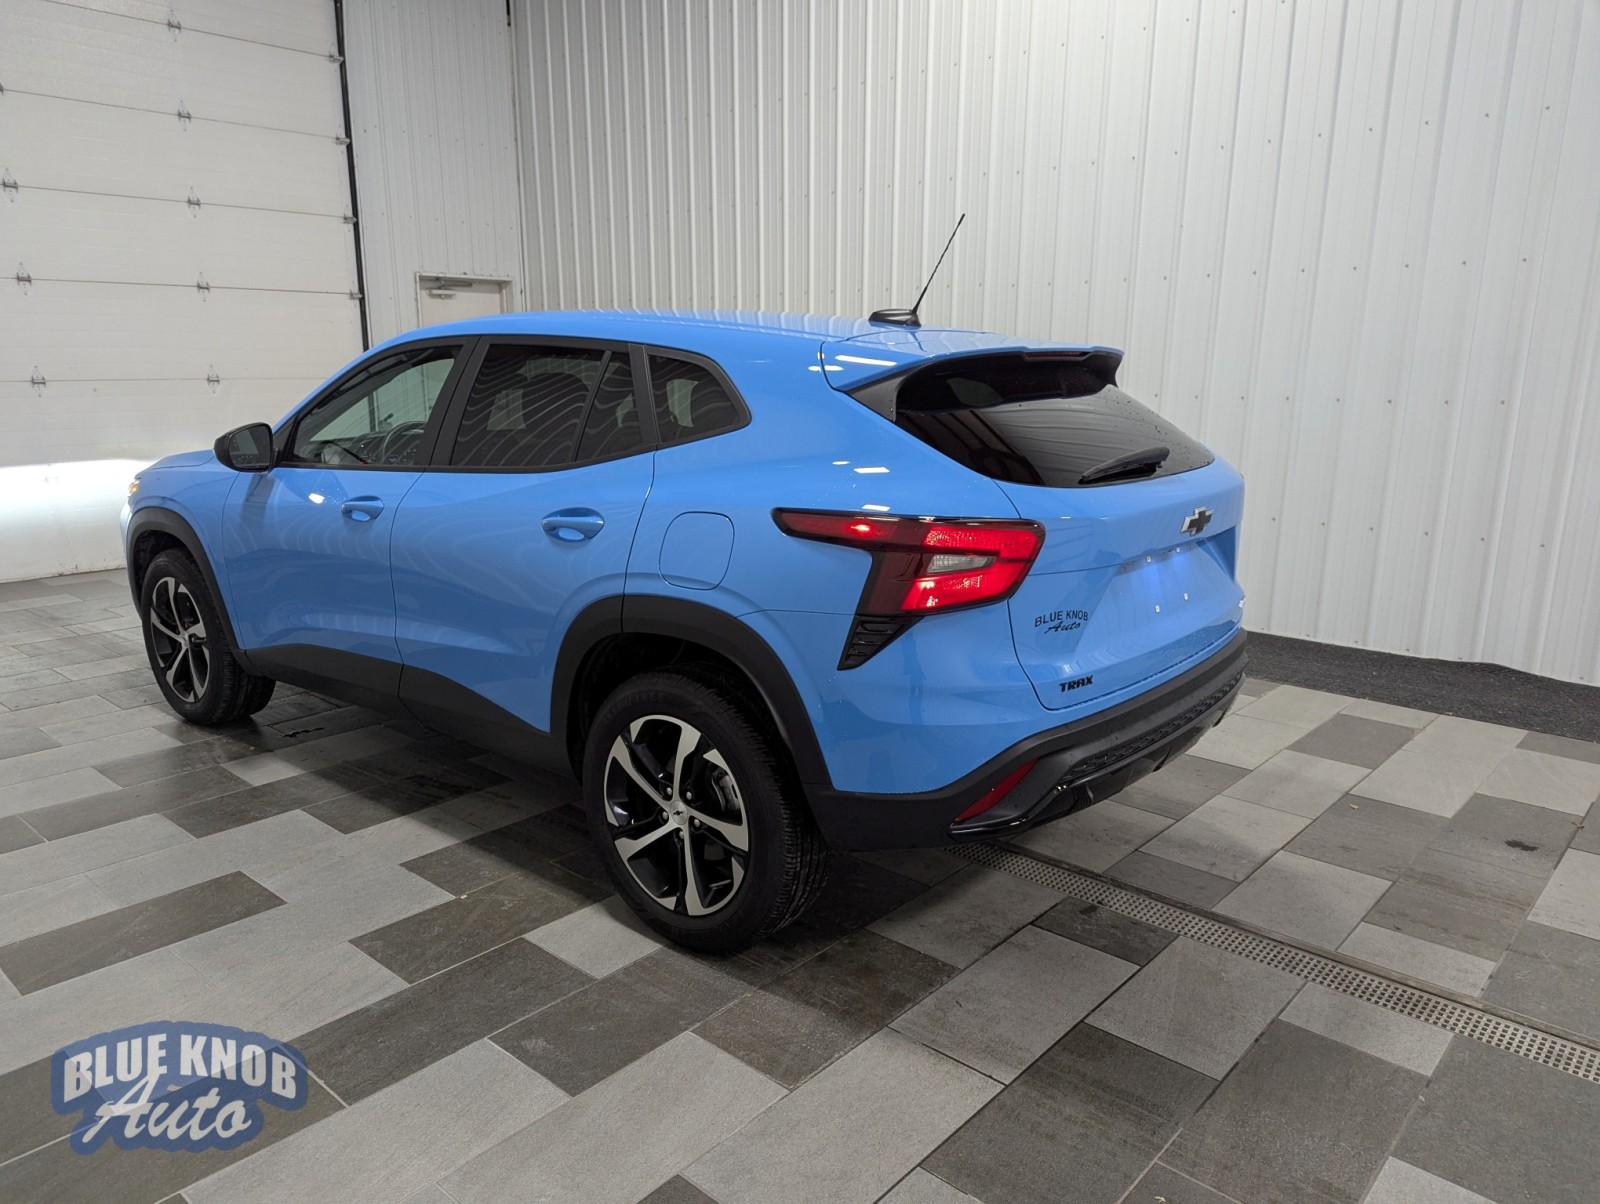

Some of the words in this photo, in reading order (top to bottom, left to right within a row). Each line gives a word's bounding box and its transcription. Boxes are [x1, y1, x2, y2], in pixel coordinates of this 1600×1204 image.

[1034, 610, 1063, 628] BLUE
[1066, 609, 1089, 621] KNOB
[1044, 620, 1081, 634] Auto
[1059, 675, 1093, 692] TRAX
